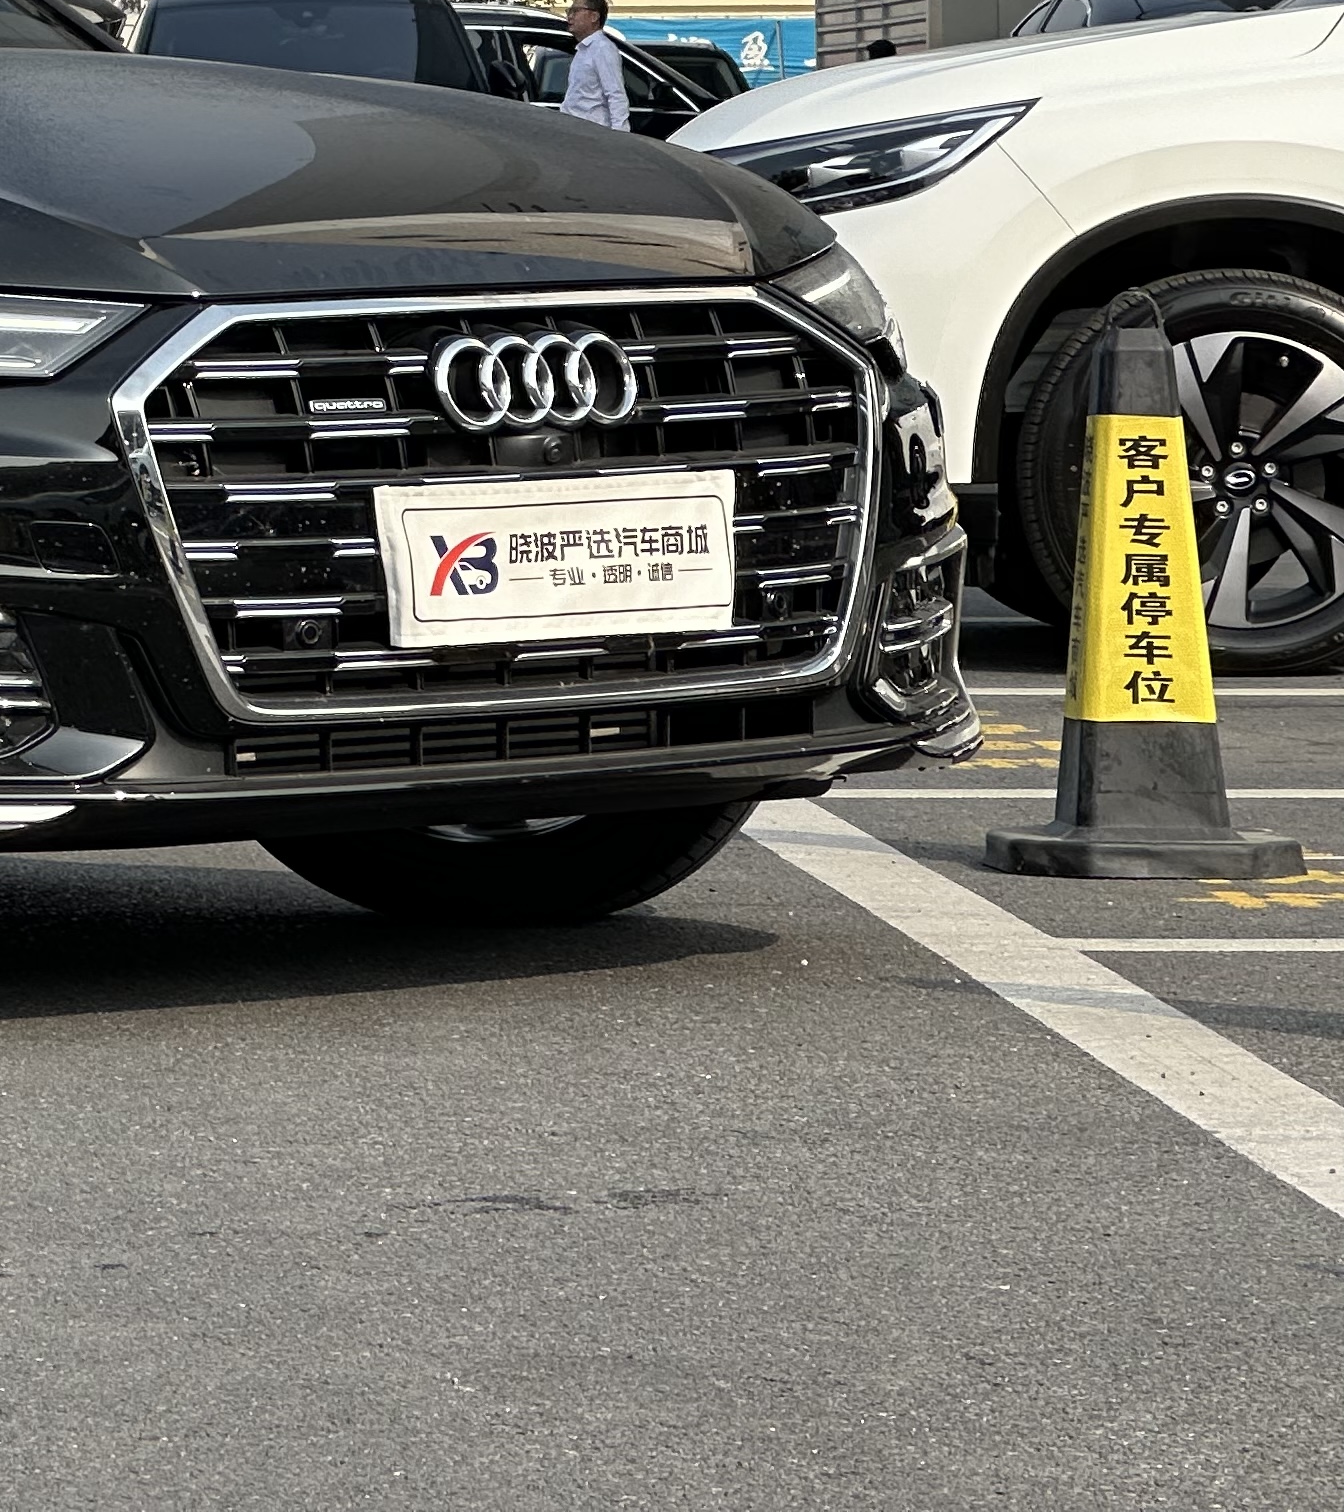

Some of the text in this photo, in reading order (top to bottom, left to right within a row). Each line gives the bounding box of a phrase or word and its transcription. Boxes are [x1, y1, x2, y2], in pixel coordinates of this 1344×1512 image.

[312, 400, 384, 412] quattro
[508, 523, 711, 565] 晓波严选汽车商城
[1117, 434, 1177, 706] 客户专属停车位
